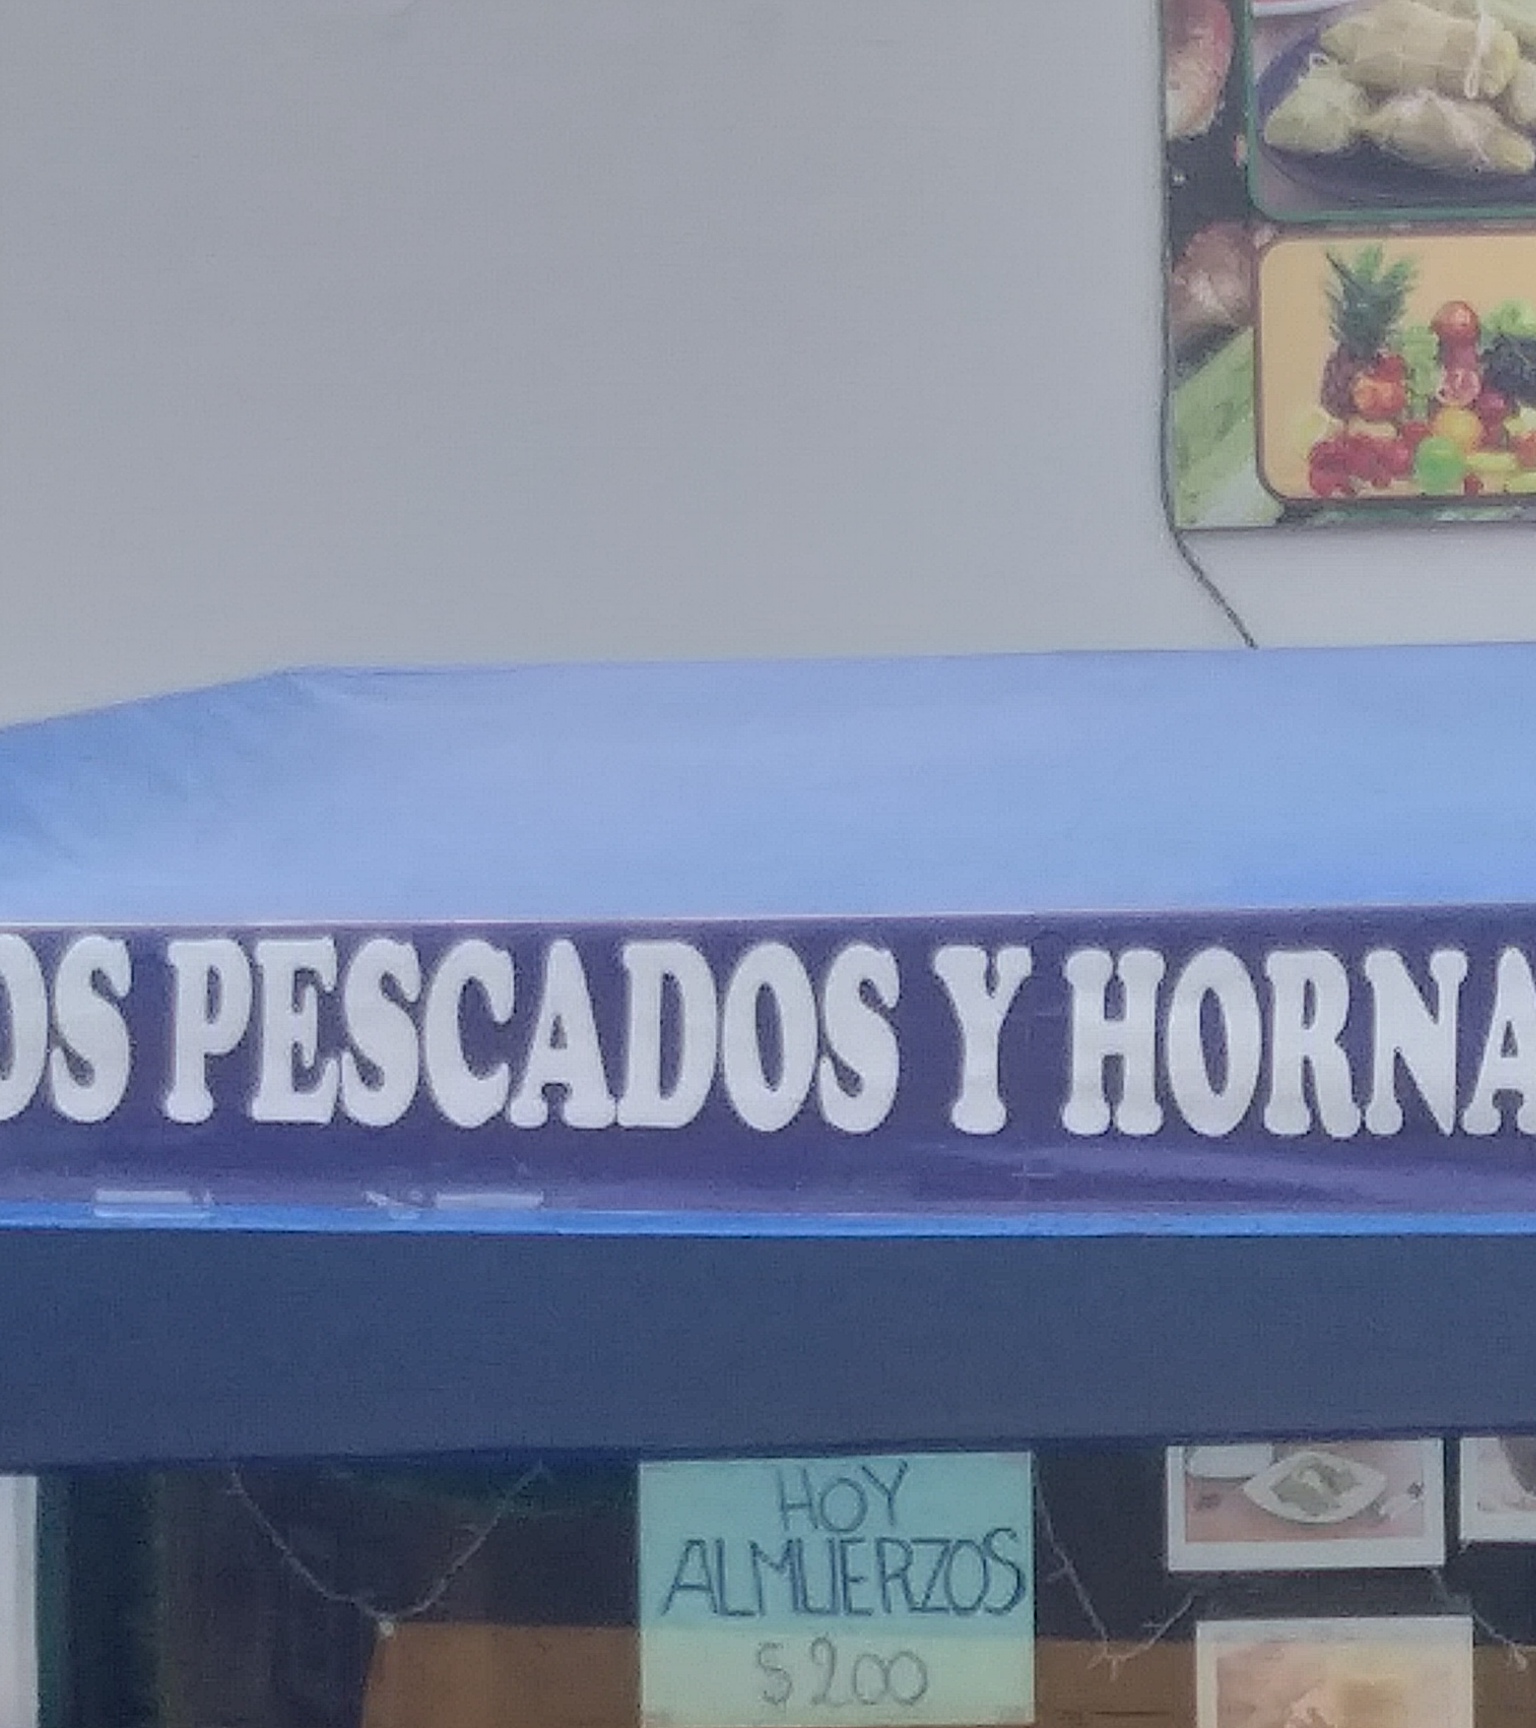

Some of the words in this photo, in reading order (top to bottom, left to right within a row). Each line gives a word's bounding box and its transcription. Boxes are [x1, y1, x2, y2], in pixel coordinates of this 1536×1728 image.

[163, 935, 900, 1133] PESCADOS
[933, 944, 1032, 1134] Y
[775, 1459, 909, 1533] HOY
[660, 1526, 1027, 1618] ALMUERZOS
